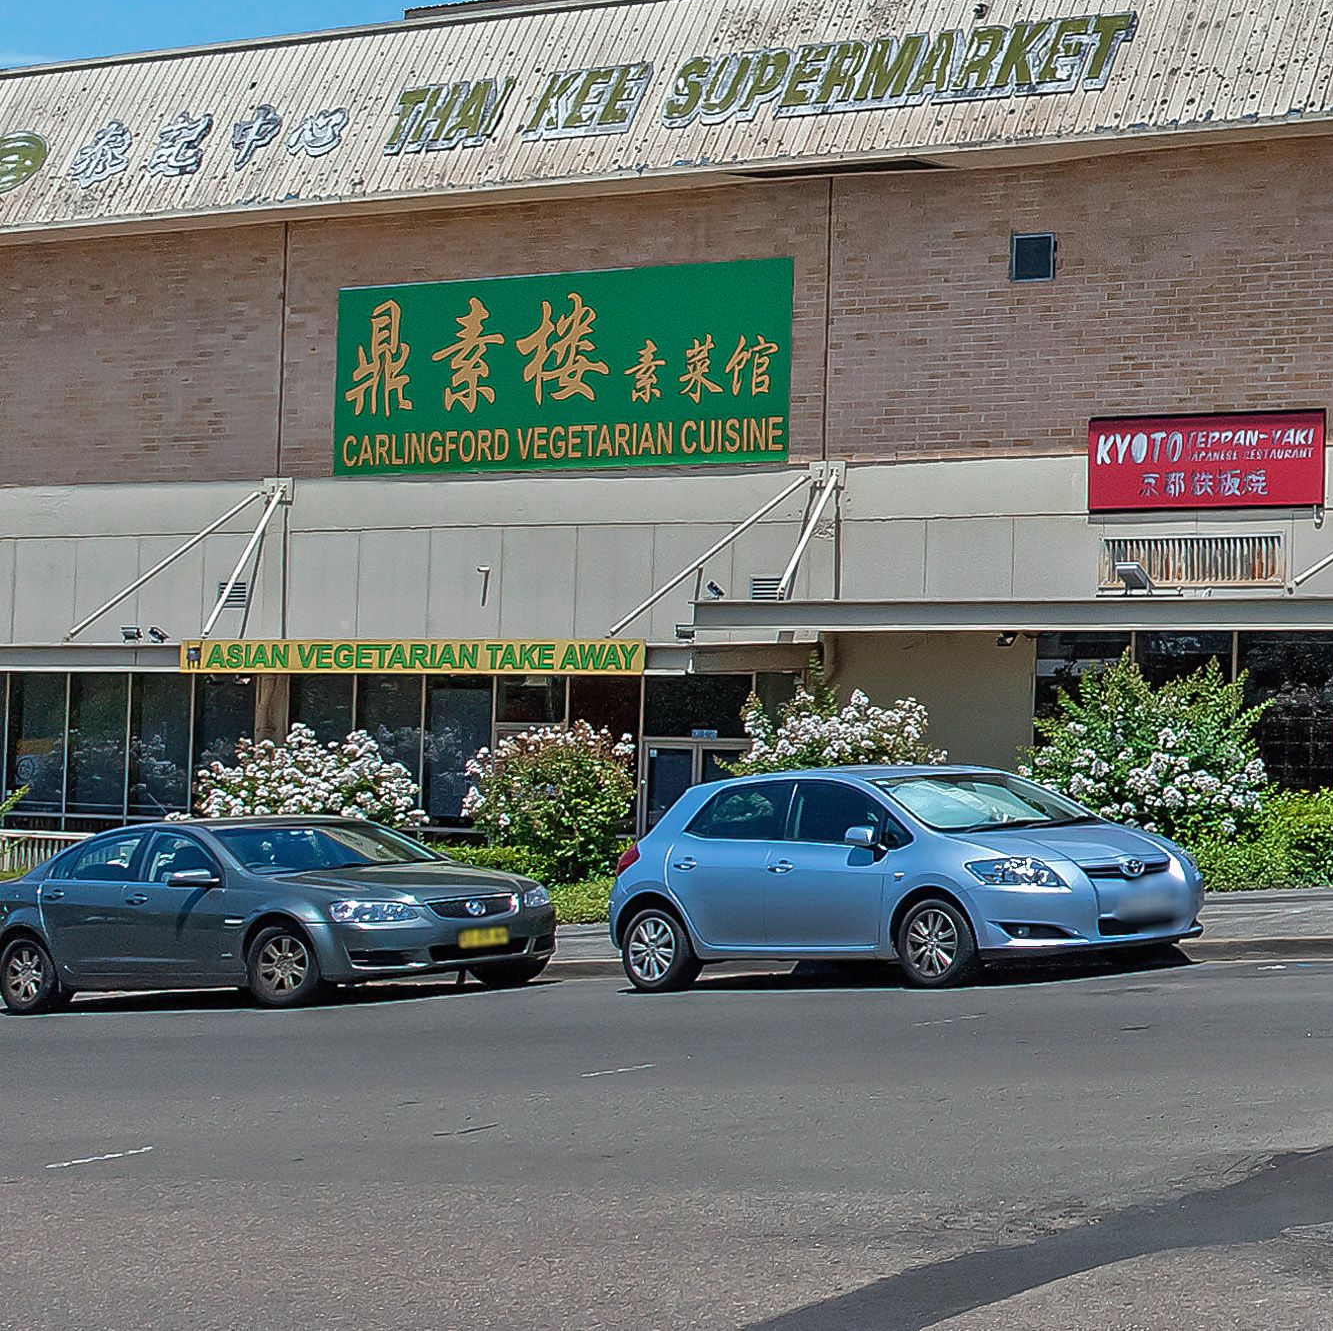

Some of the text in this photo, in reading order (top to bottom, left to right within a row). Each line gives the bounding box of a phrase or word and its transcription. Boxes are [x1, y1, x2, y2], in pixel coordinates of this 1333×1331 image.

[382, 10, 1139, 157] THAI KEE SUPERMARKET
[624, 333, 780, 405] 素菜馆
[342, 416, 785, 468] CARLINGFORD VEGETARIAN CUISINE
[1096, 430, 1183, 465] KYOTO
[1187, 428, 1315, 448] TEPPAN-YAKI
[1243, 447, 1314, 460] RESTAURANT
[206, 643, 640, 669] ASIAN VEGETARIAN TAKE AWAY
